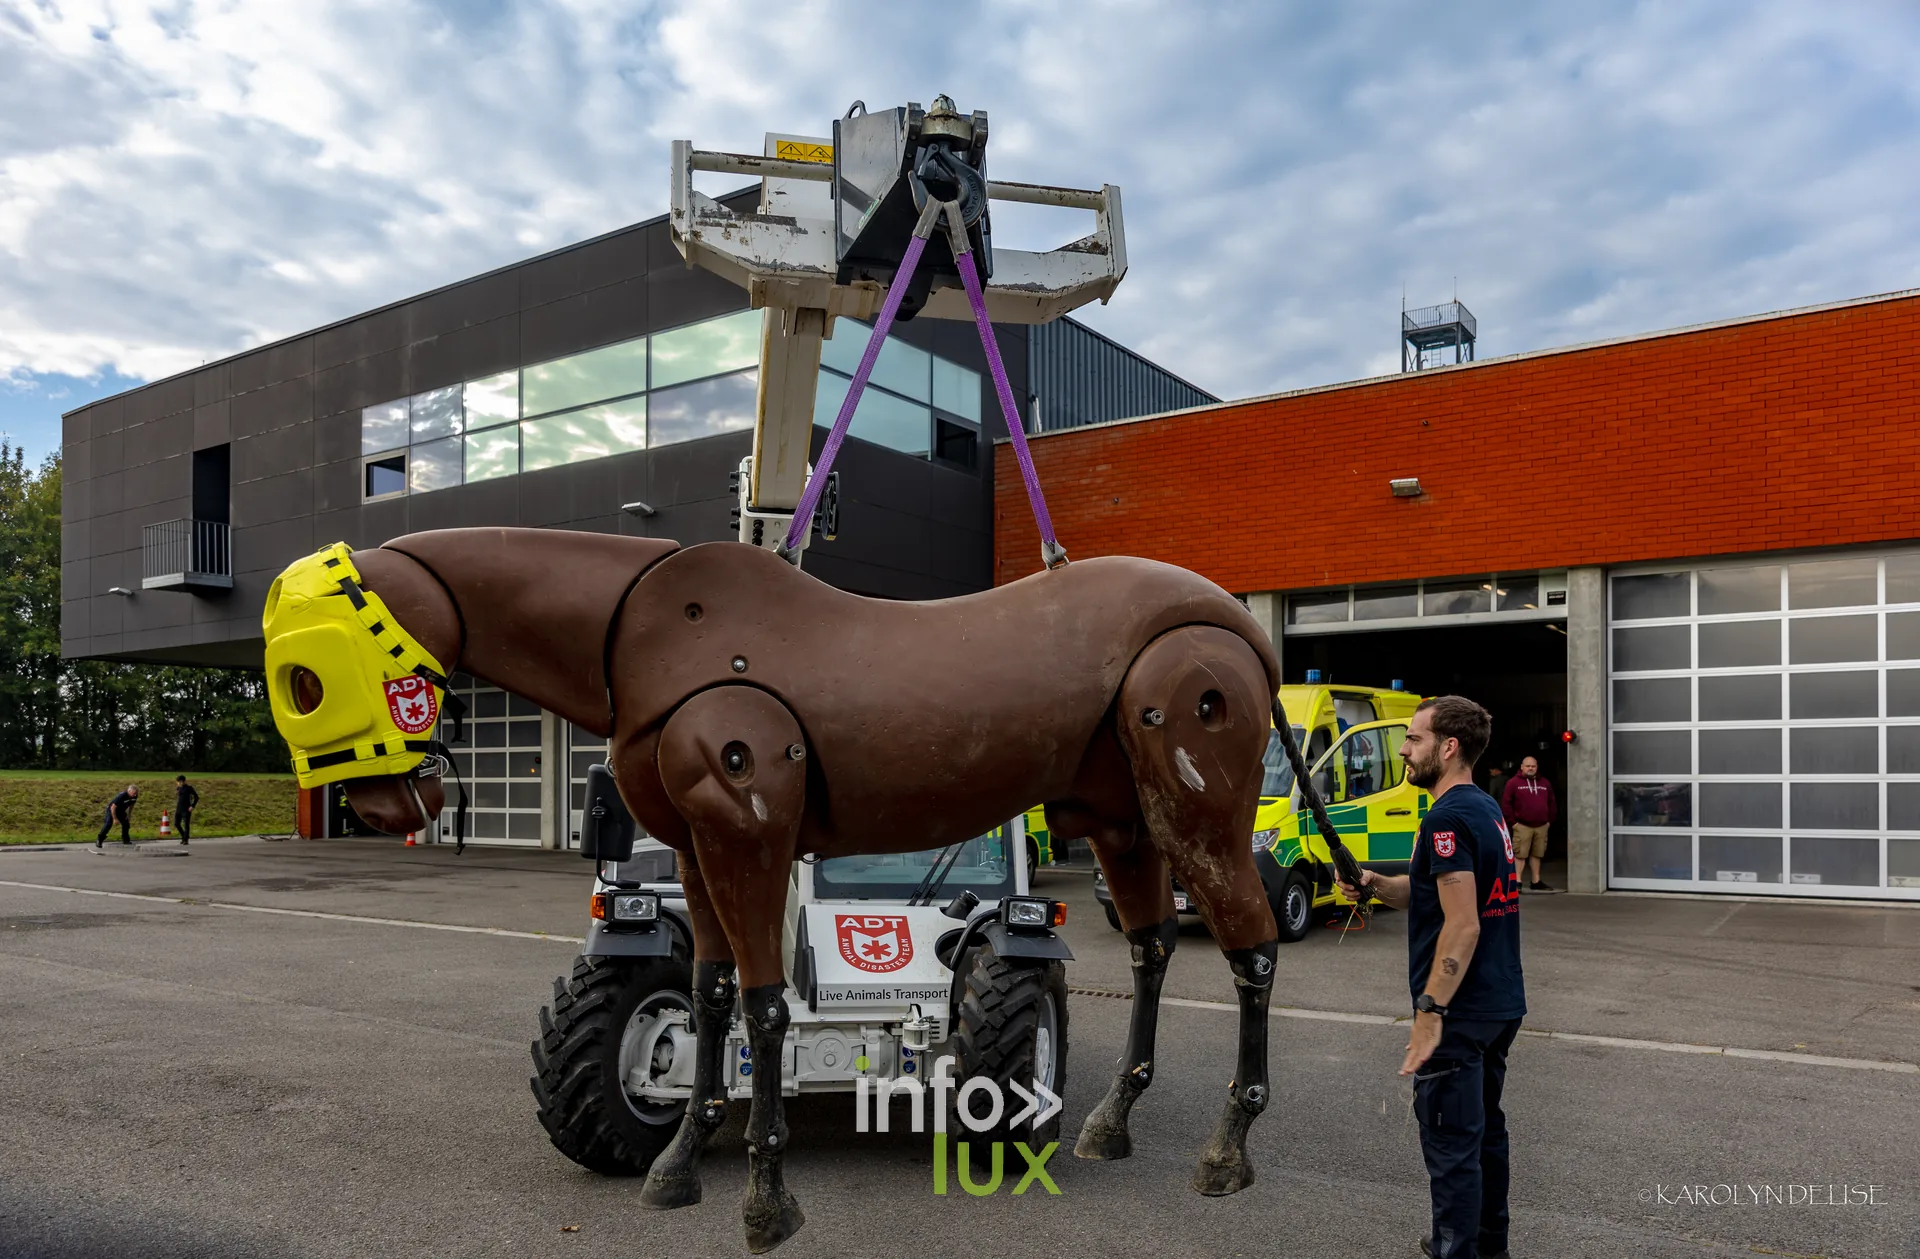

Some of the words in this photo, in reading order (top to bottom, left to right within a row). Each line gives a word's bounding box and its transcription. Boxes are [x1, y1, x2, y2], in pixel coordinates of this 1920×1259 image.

[388, 677, 426, 695] ADT
[391, 705, 405, 729] ANIMAL
[407, 714, 435, 732] DISASTER
[428, 695, 436, 713] TEAM
[840, 917, 903, 929] ADT
[841, 937, 857, 964] ANIMAL
[859, 957, 907, 971] DISASTER
[901, 938, 910, 956] TEAM
[819, 990, 843, 1001] Live
[845, 988, 892, 1001] Animals
[893, 988, 949, 1001] Transport
